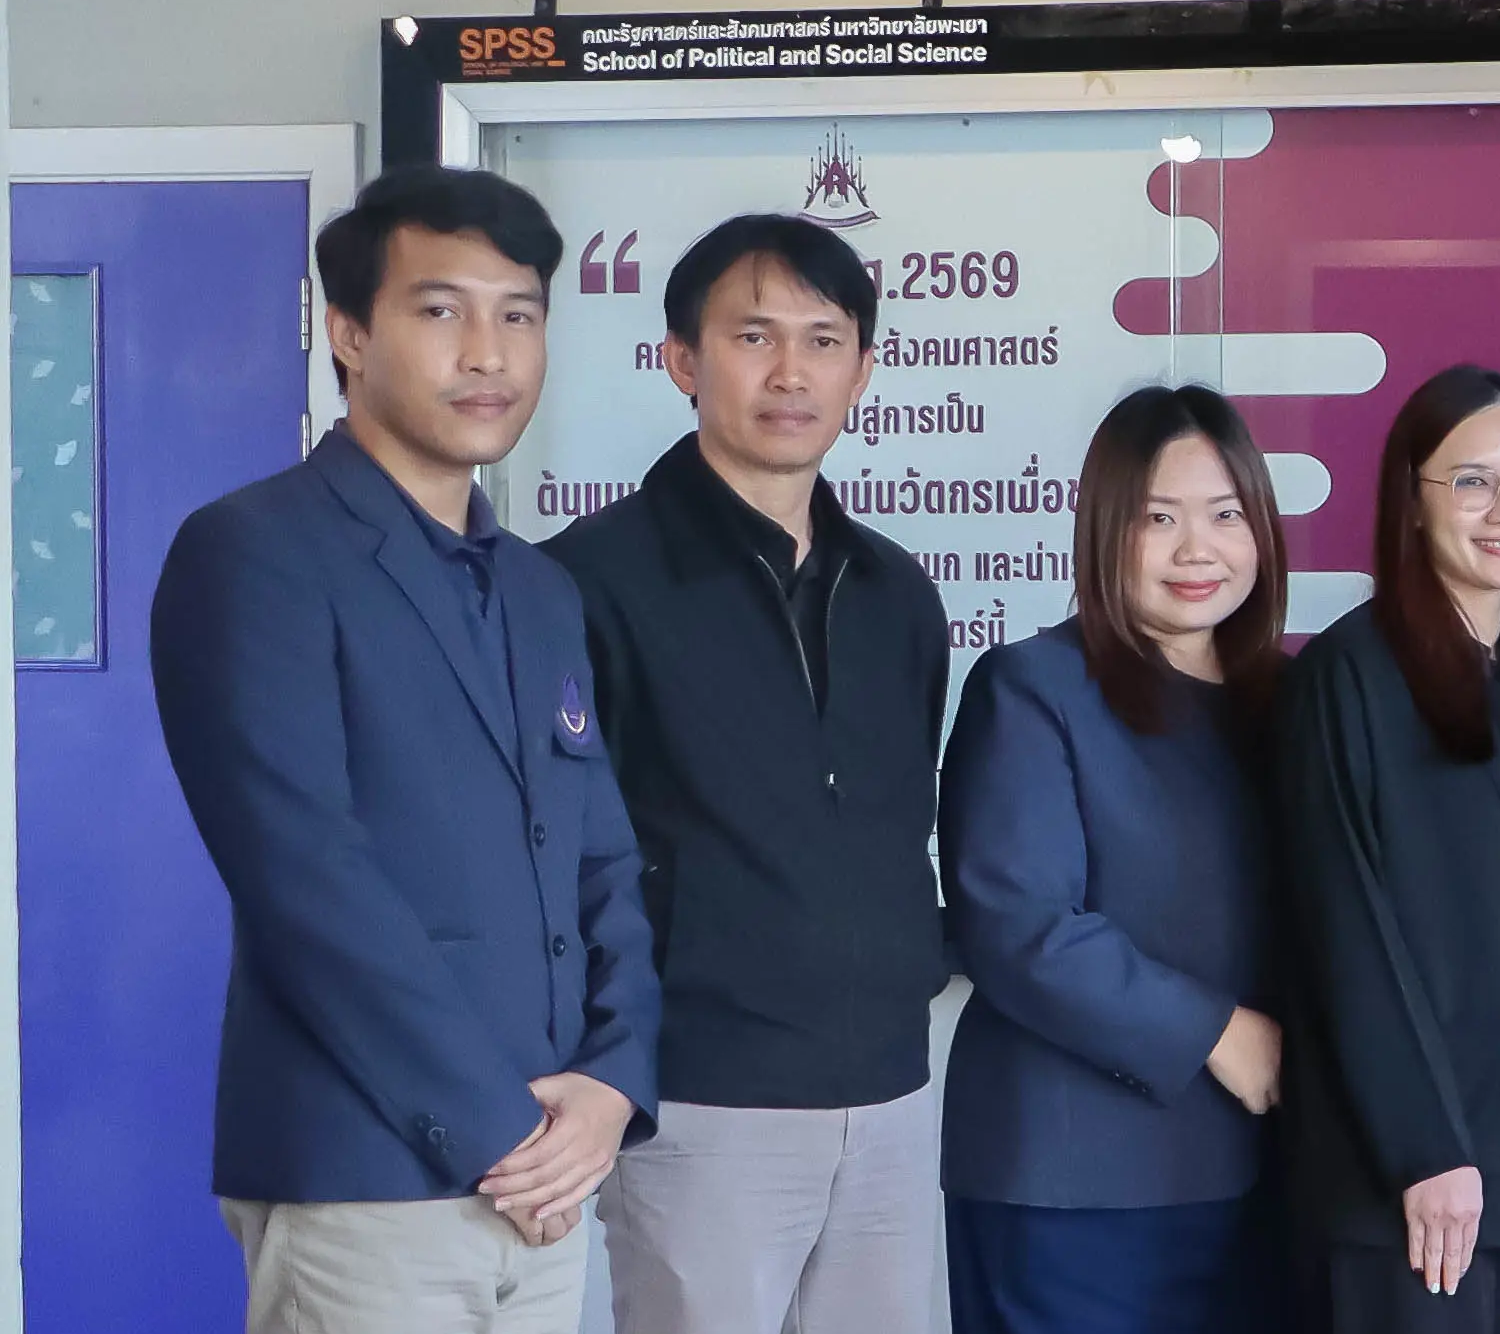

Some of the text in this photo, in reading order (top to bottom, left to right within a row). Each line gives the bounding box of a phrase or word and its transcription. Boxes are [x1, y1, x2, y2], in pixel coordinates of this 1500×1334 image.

[459, 26, 556, 61] SPSS
[583, 14, 988, 47] คณะรัฐศาสตร์และสังคมศาสตร์ มหาวิทยาลัยพะเยา
[583, 41, 987, 72] School of Political and Social Science
